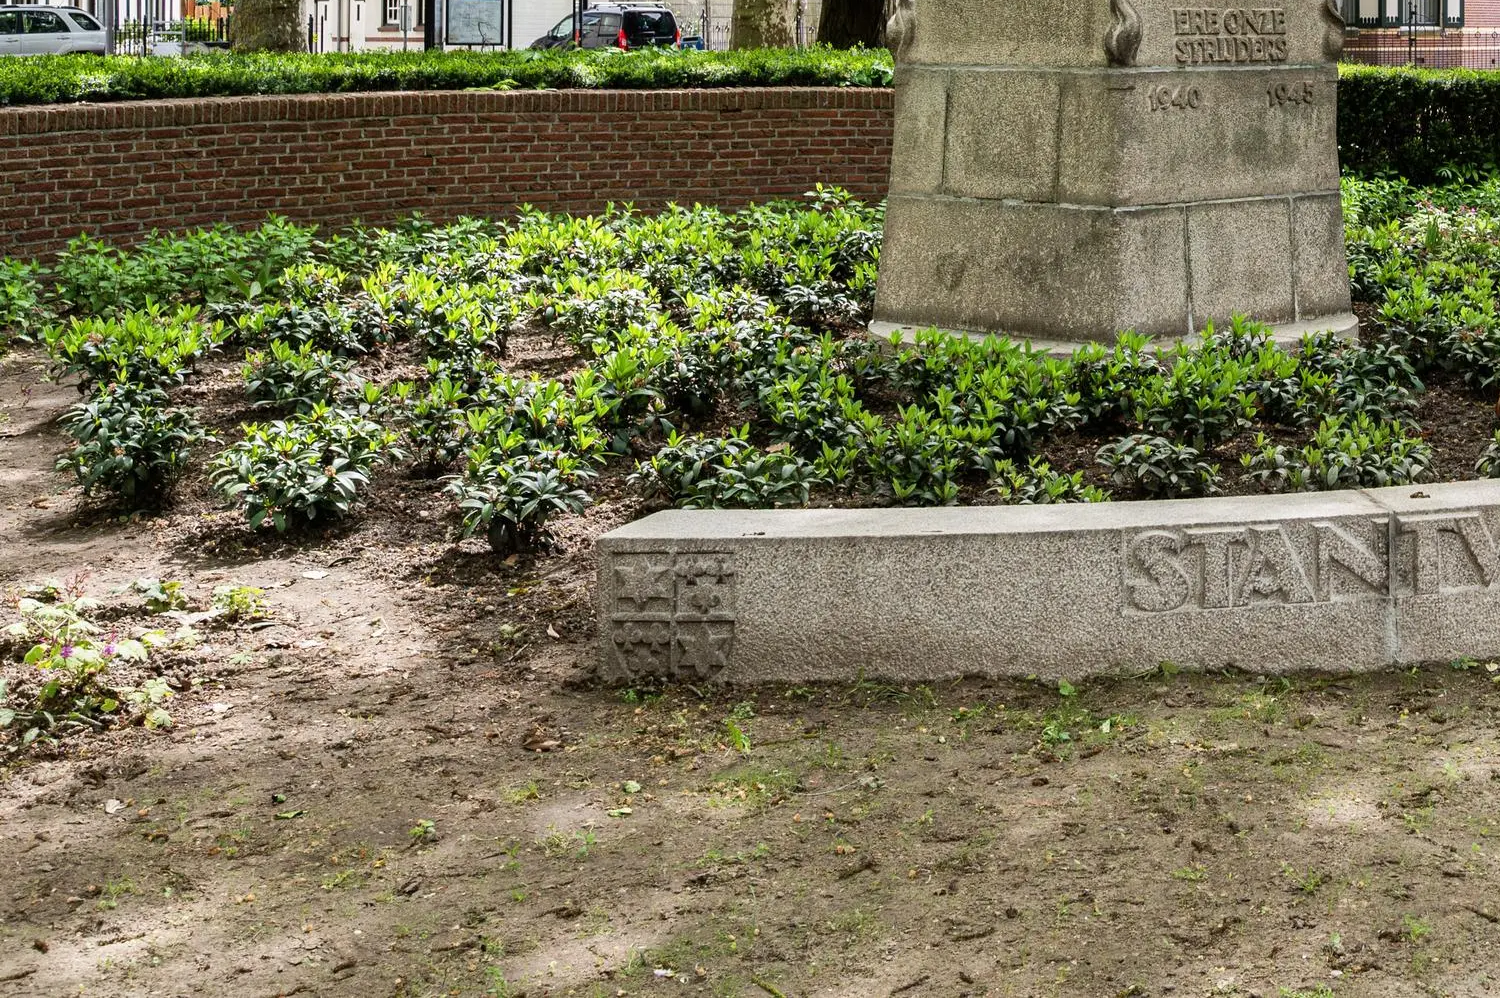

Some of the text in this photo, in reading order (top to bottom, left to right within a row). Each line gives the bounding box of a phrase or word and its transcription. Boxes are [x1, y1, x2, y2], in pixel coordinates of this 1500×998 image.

[1171, 8, 1287, 36] ERE ONZE
[1174, 37, 1287, 64] STRIJDERS
[1148, 80, 1314, 112] 1940 1945
